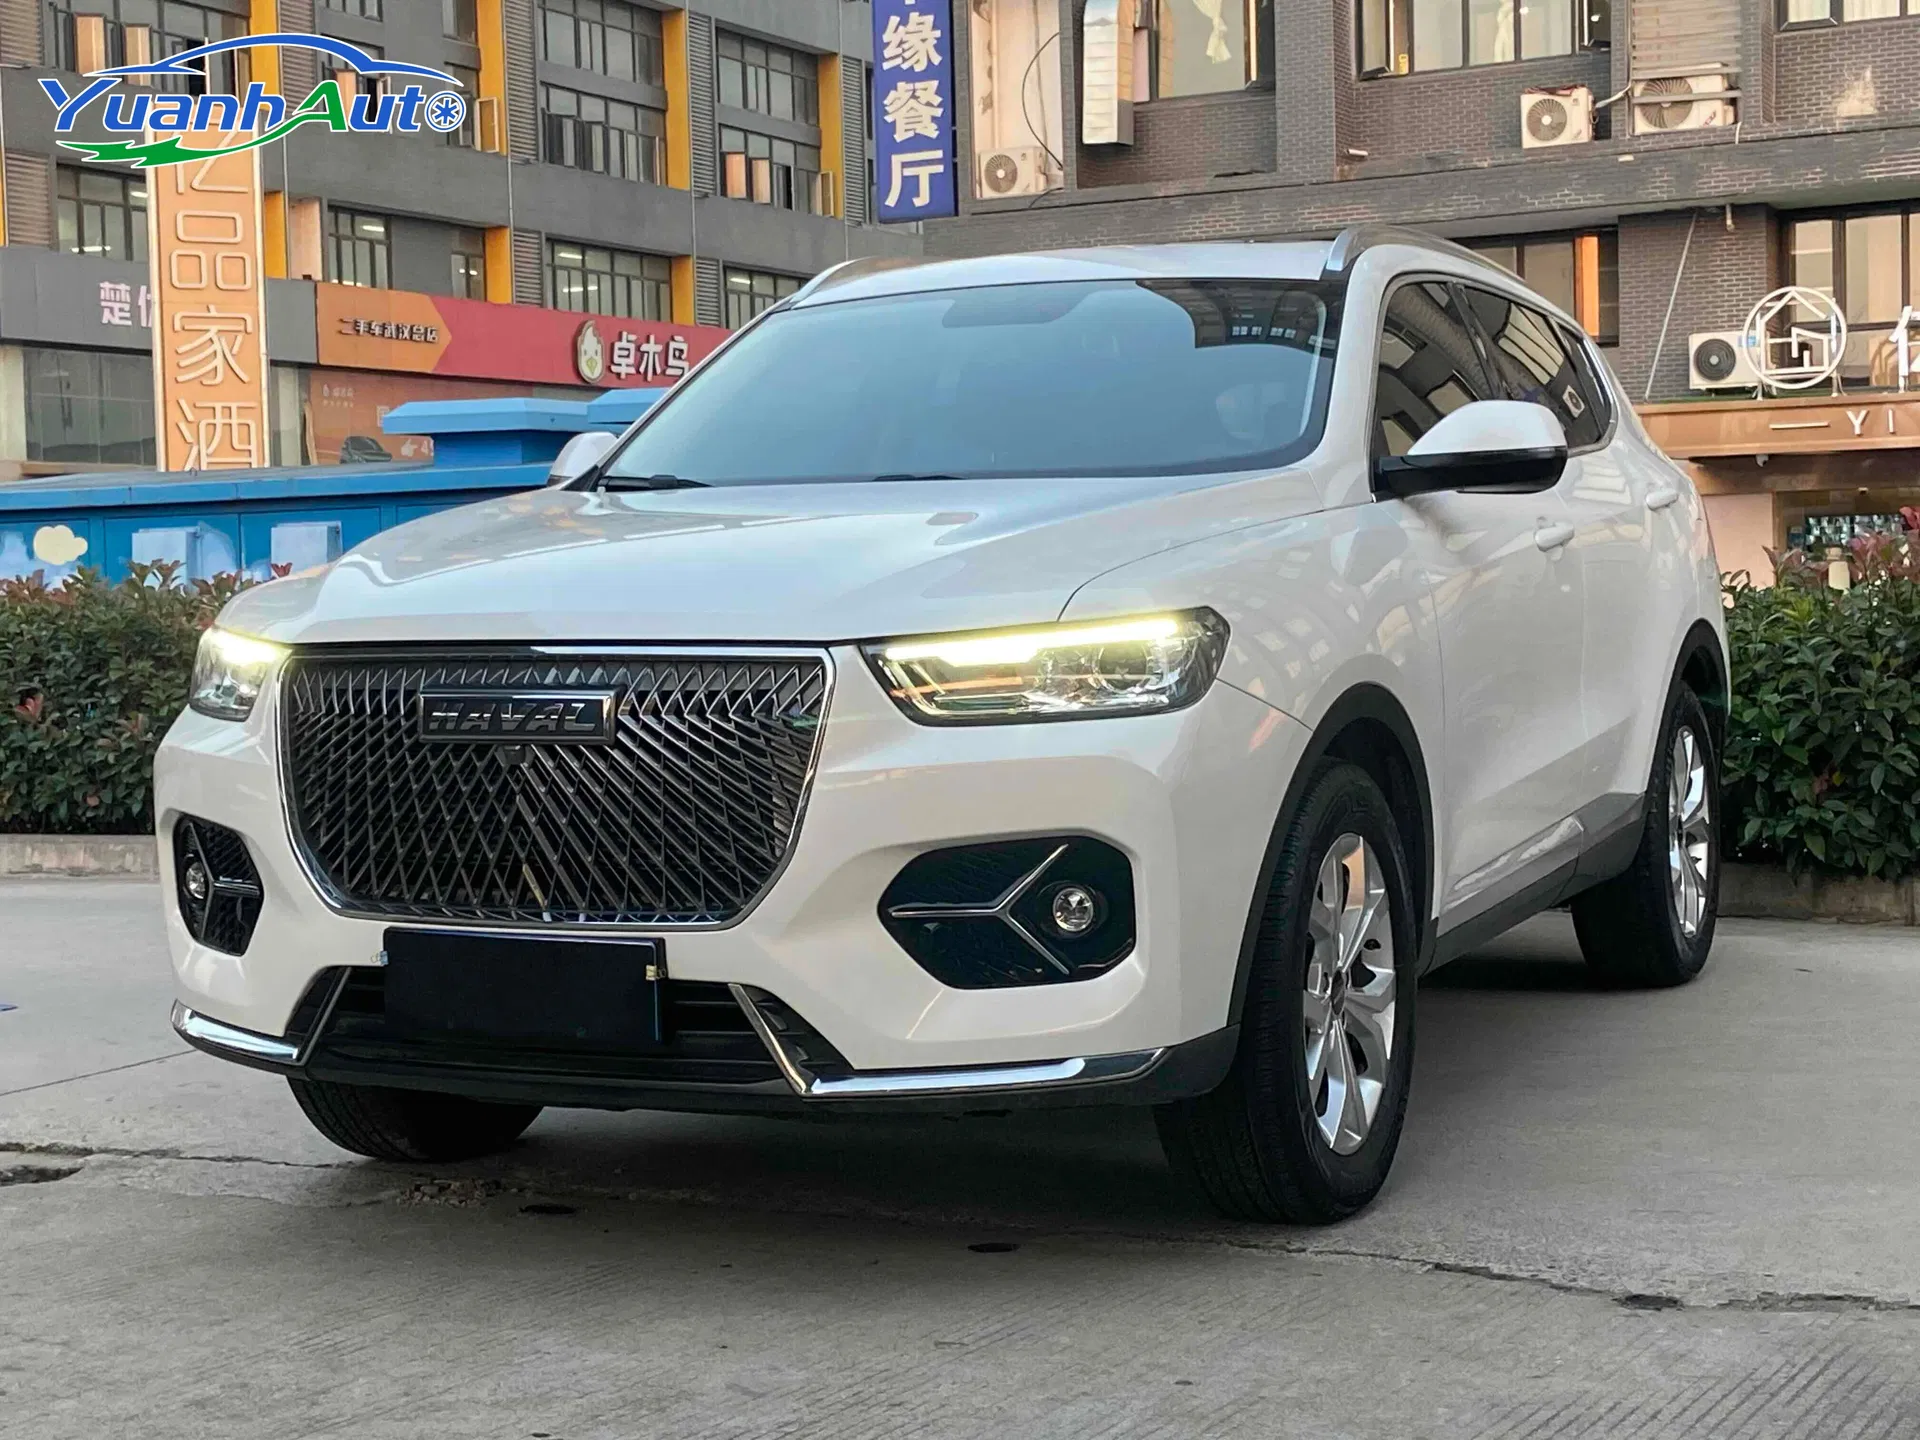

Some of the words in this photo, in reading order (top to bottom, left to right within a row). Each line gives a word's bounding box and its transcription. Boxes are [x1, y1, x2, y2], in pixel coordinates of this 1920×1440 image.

[882, 0, 945, 208] 缘餐厅
[338, 317, 439, 343] 二手车武汉总店
[611, 331, 690, 382] 卓木鸟
[428, 702, 596, 731] HAVAL
